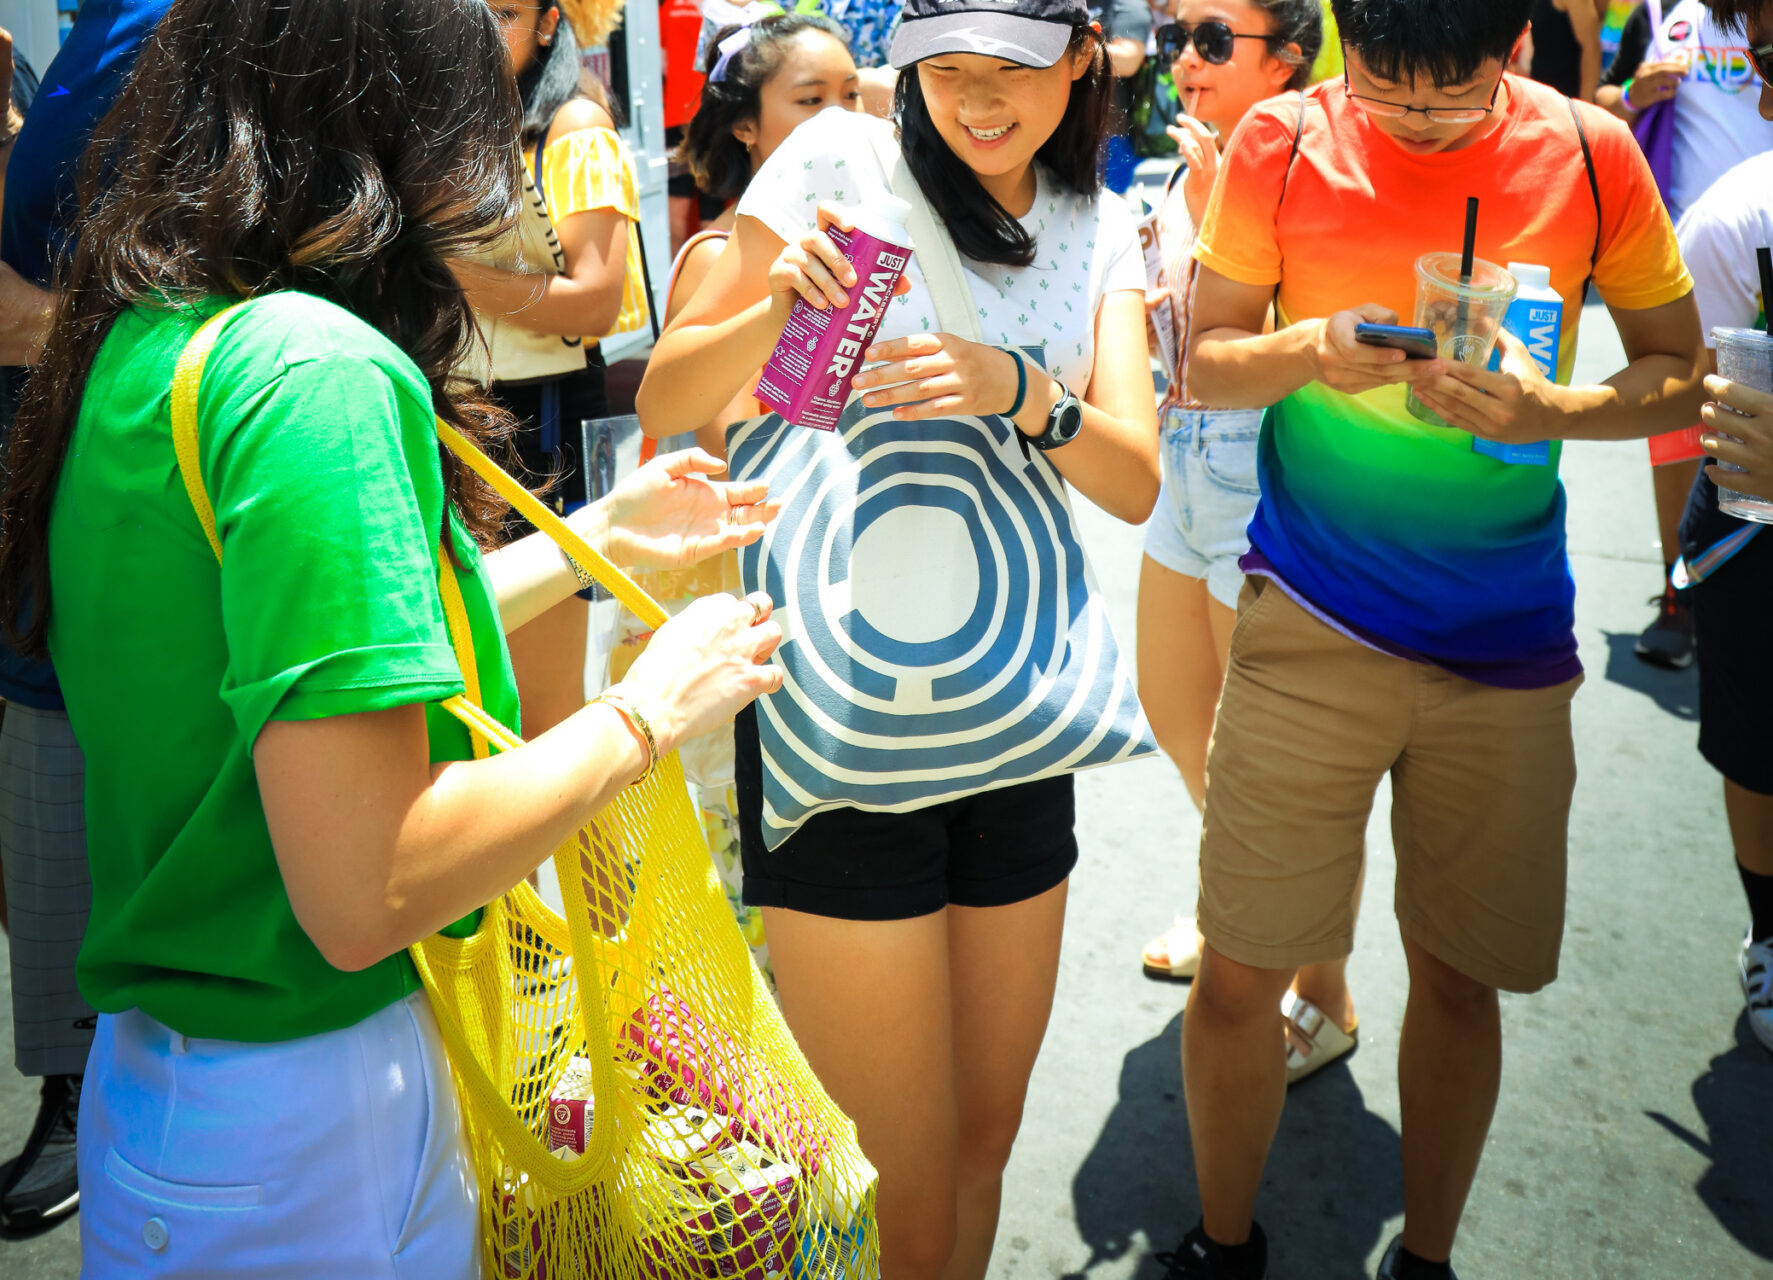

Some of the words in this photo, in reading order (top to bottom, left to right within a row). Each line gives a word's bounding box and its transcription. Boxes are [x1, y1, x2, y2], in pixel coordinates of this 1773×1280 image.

[880, 254, 903, 269] JUST
[1531, 308, 1556, 322] JUST
[826, 271, 894, 378] WATER
